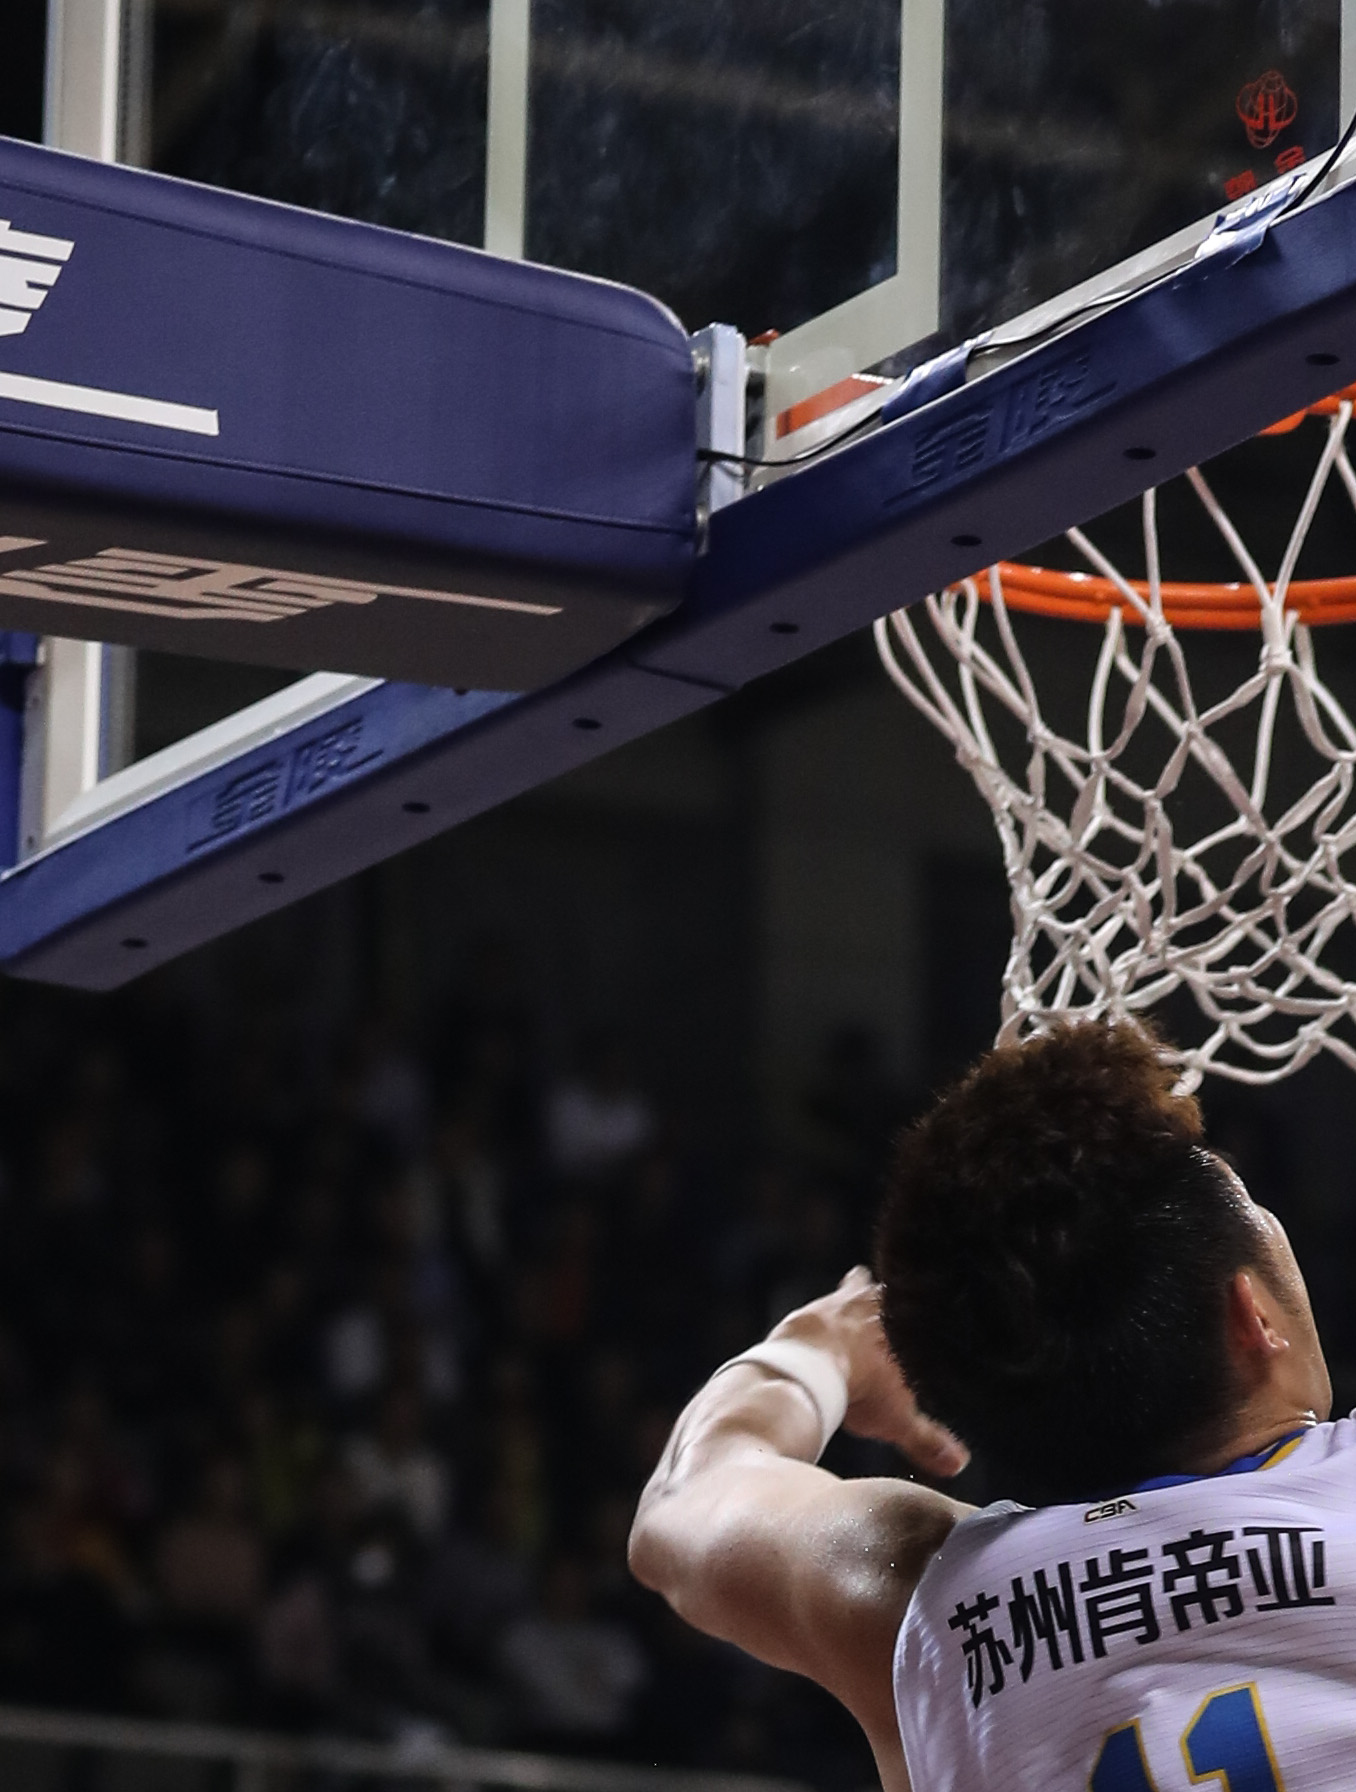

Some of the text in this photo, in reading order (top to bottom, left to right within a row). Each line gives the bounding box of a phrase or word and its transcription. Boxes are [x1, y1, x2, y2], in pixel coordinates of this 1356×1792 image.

[1084, 1499, 1136, 1523] CBA
[948, 1526, 1336, 1708] 苏州肯帝亚
